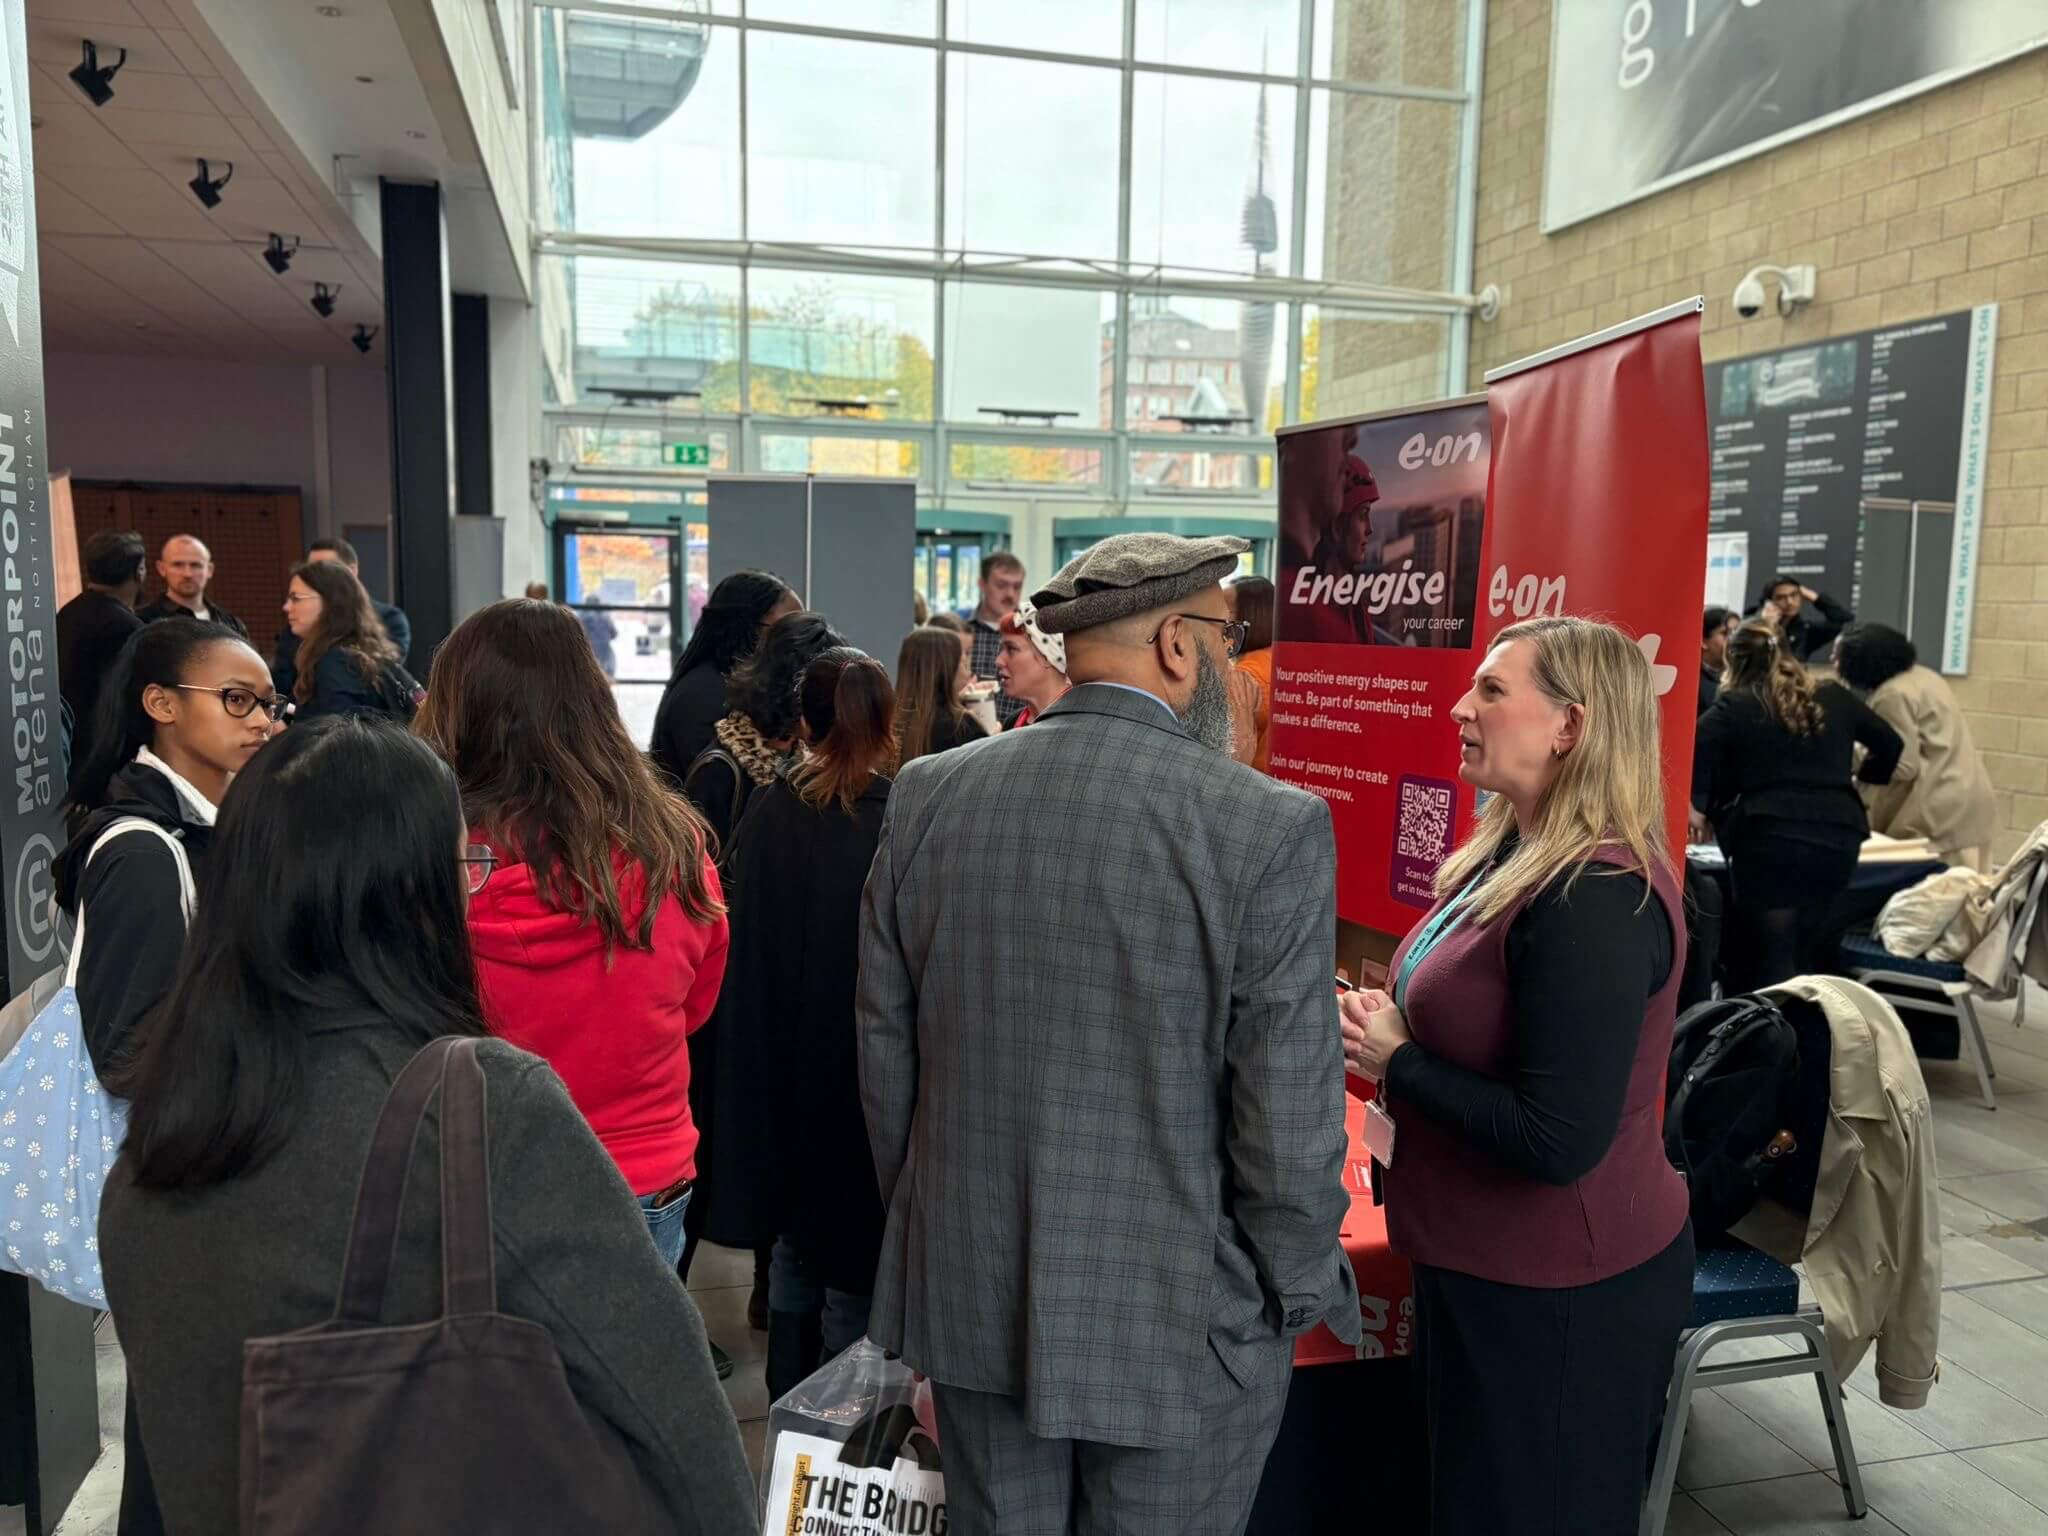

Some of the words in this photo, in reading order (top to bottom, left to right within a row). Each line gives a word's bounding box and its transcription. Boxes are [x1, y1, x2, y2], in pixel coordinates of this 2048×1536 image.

[1978, 308, 1990, 332] ON
[1974, 334, 1988, 395] WHAT'S
[1971, 402, 1982, 425] ON
[1967, 428, 1980, 488] WHAT'S
[24, 408, 40, 608] NOTTINGHAM
[1963, 495, 1974, 517] ON
[1959, 519, 1972, 578] WHAT'S
[1289, 560, 1446, 615] Energise
[1955, 586, 1966, 608] ON
[0, 412, 34, 815] MOTORPOINT
[1403, 618, 1426, 633] your
[1428, 617, 1465, 630] career
[1951, 611, 1965, 668] WHAT'S
[1275, 667, 1295, 681] Your
[1296, 669, 1334, 684] positive
[1336, 673, 1371, 691] energy
[1372, 673, 1409, 692] shapes
[1411, 680, 1428, 692] our
[27, 629, 51, 806] arena
[1274, 688, 1304, 704] future.
[1306, 690, 1319, 705] Be
[1320, 694, 1341, 710] part
[1342, 695, 1353, 709] of
[1354, 698, 1409, 719] something
[1411, 702, 1432, 718] that
[1272, 711, 1300, 726] makes
[1302, 718, 1309, 727] a
[1311, 714, 1362, 734] difference.
[1270, 752, 1287, 768] Join
[1288, 758, 1306, 770] our
[1306, 757, 1342, 780] journey
[1343, 765, 1354, 779] to
[1355, 771, 1388, 785] create
[1303, 780, 1354, 802] tomorrow.
[1405, 866, 1421, 879] Scan
[1422, 873, 1431, 882] to
[1397, 882, 1408, 893] get
[1408, 883, 1416, 894] in
[1416, 887, 1437, 899] touch
[802, 1475, 858, 1518] THE
